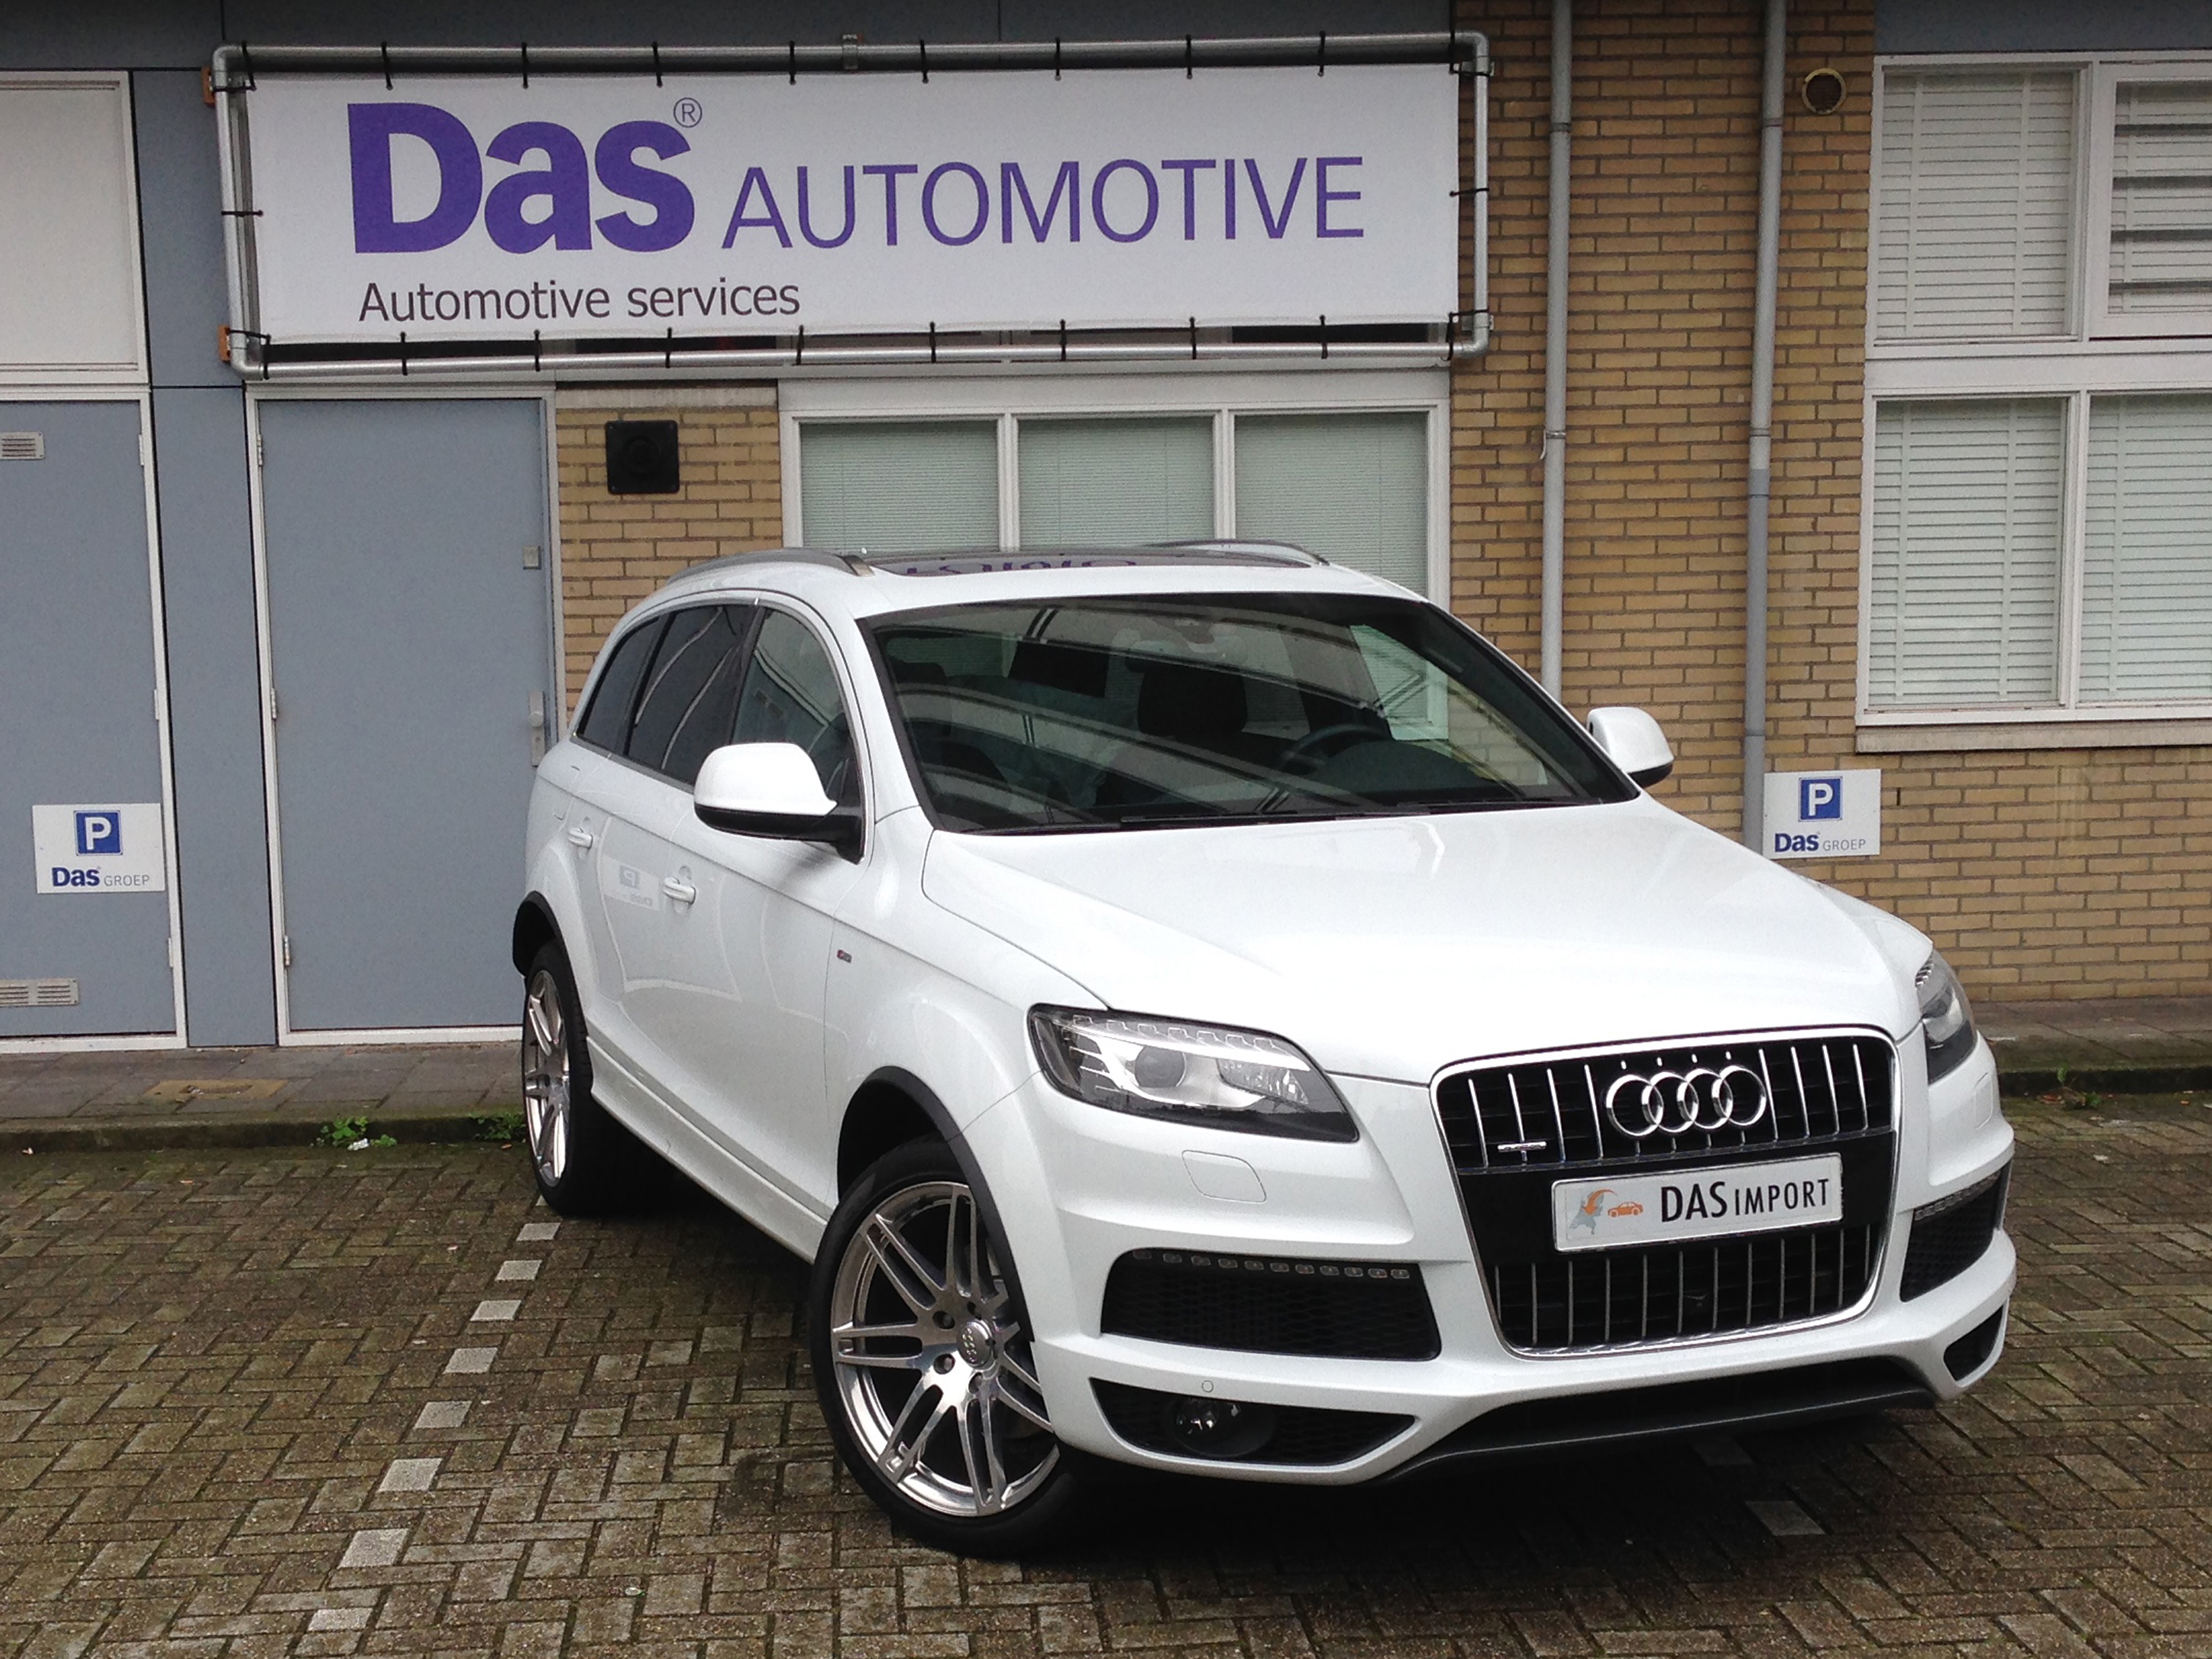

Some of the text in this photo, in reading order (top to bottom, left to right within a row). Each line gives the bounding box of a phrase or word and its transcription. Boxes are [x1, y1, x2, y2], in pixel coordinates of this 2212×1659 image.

[348, 103, 695, 253] Das
[721, 156, 1364, 249] AUTOMOTIVE
[359, 277, 801, 321] Automotive services
[1808, 783, 1834, 817] P
[84, 817, 112, 851] P
[1775, 833, 1866, 853] Das GROEP
[52, 867, 150, 887] Das GROEP
[1661, 1178, 1829, 1222] DAS IMPORT
